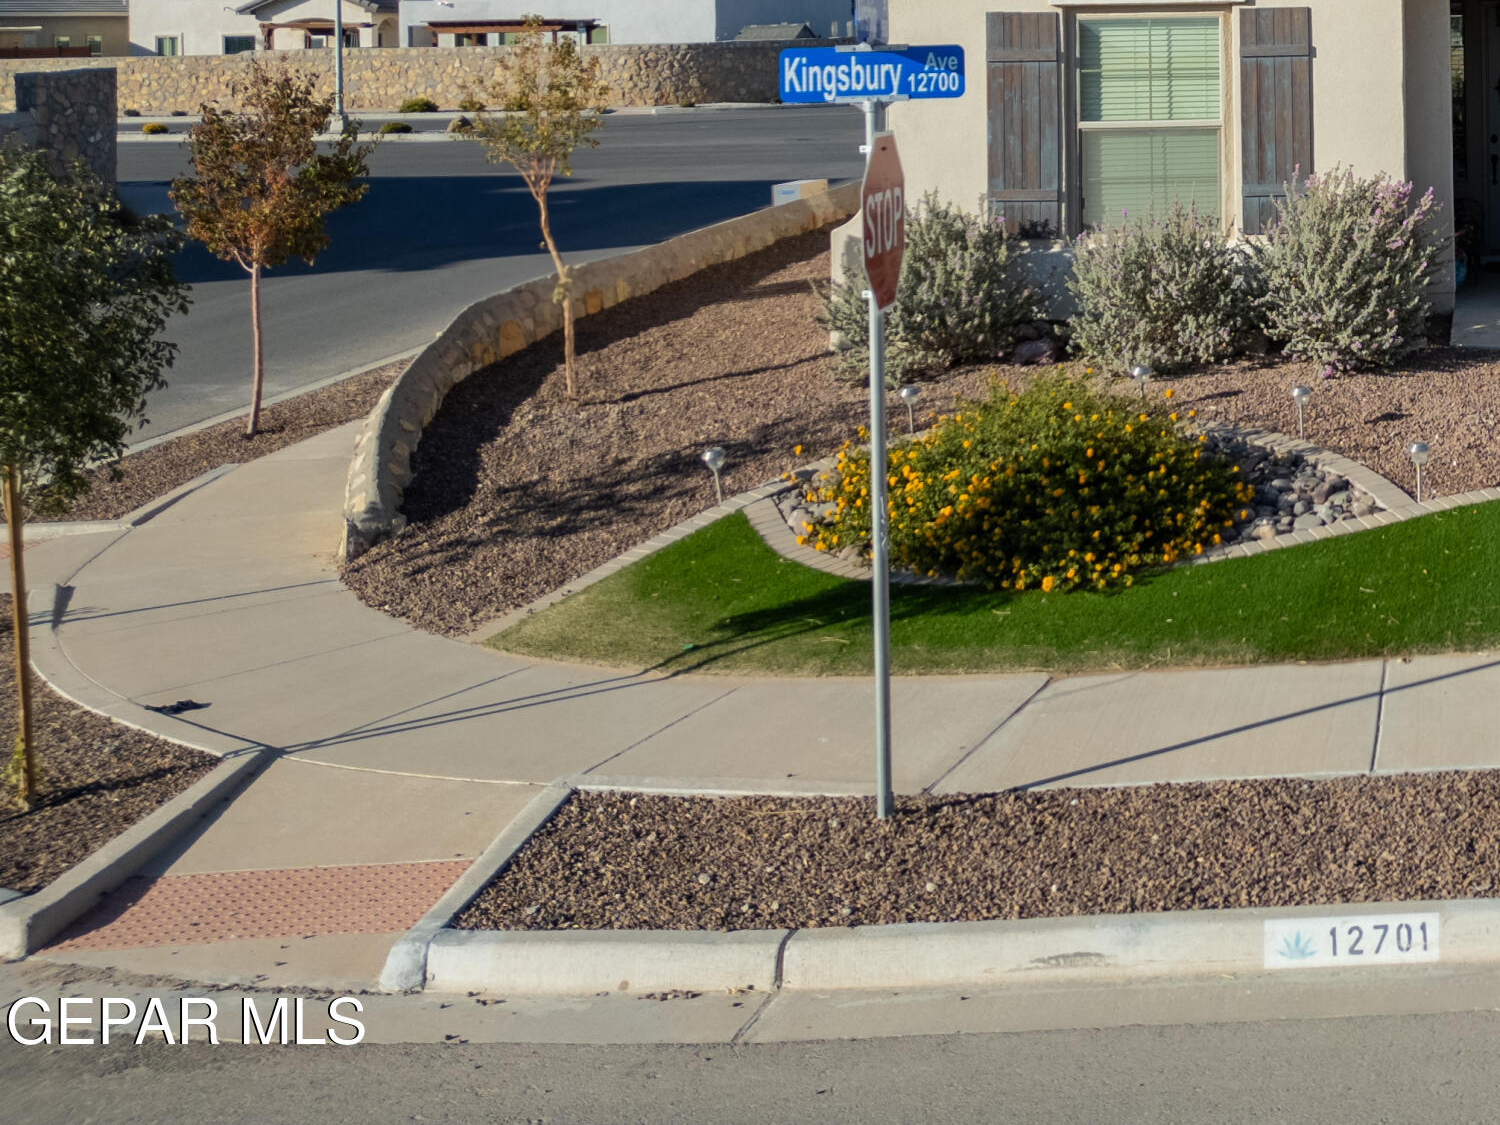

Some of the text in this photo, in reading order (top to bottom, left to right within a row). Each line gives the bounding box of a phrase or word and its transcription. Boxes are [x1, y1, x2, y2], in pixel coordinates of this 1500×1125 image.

[784, 56, 902, 101] Kingsbury
[924, 52, 958, 71] Ave
[907, 72, 959, 92] 12700
[866, 187, 902, 258] STOP
[1329, 921, 1428, 956] 12701
